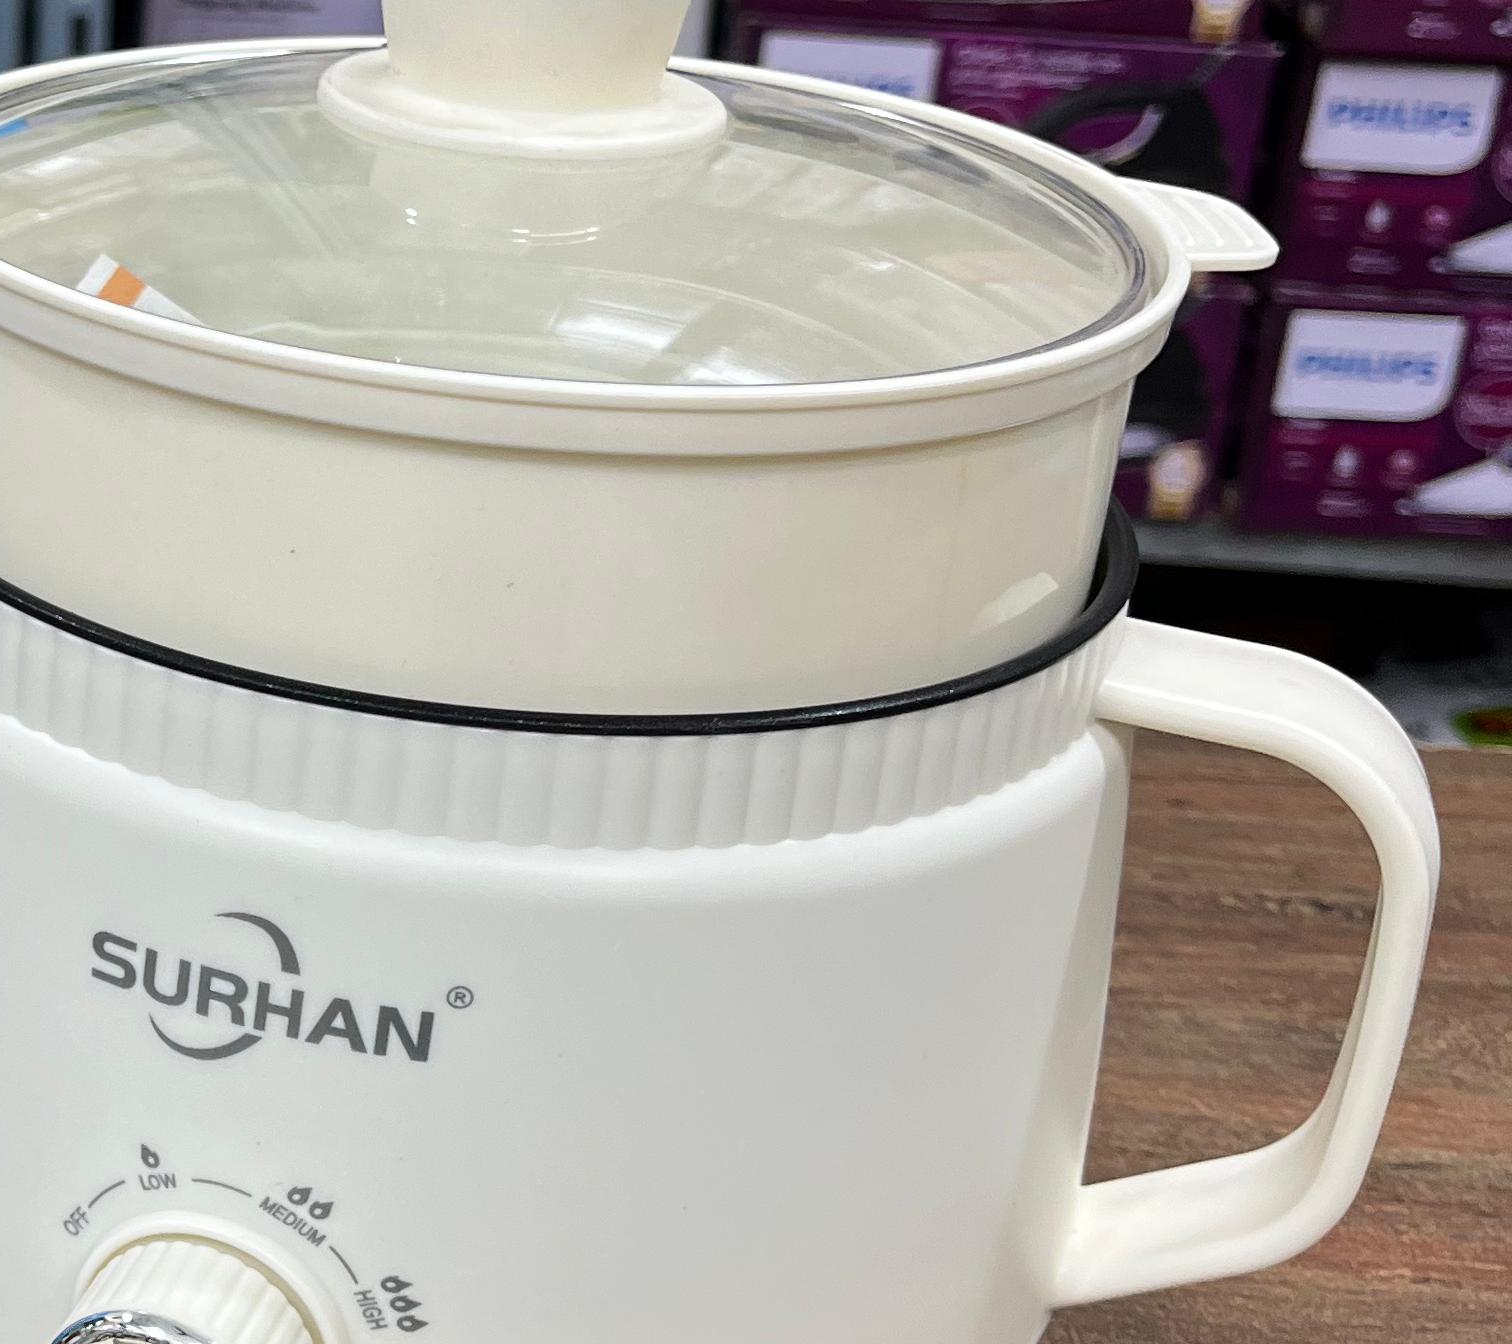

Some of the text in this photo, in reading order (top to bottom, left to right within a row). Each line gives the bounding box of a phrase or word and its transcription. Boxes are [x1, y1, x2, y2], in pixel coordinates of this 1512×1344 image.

[91, 930, 436, 1063] SURHAN
[138, 1172, 178, 1192] LOW
[63, 1209, 91, 1237] OFF
[258, 1195, 327, 1248] MEDIUM
[353, 1288, 389, 1332] HIGH
